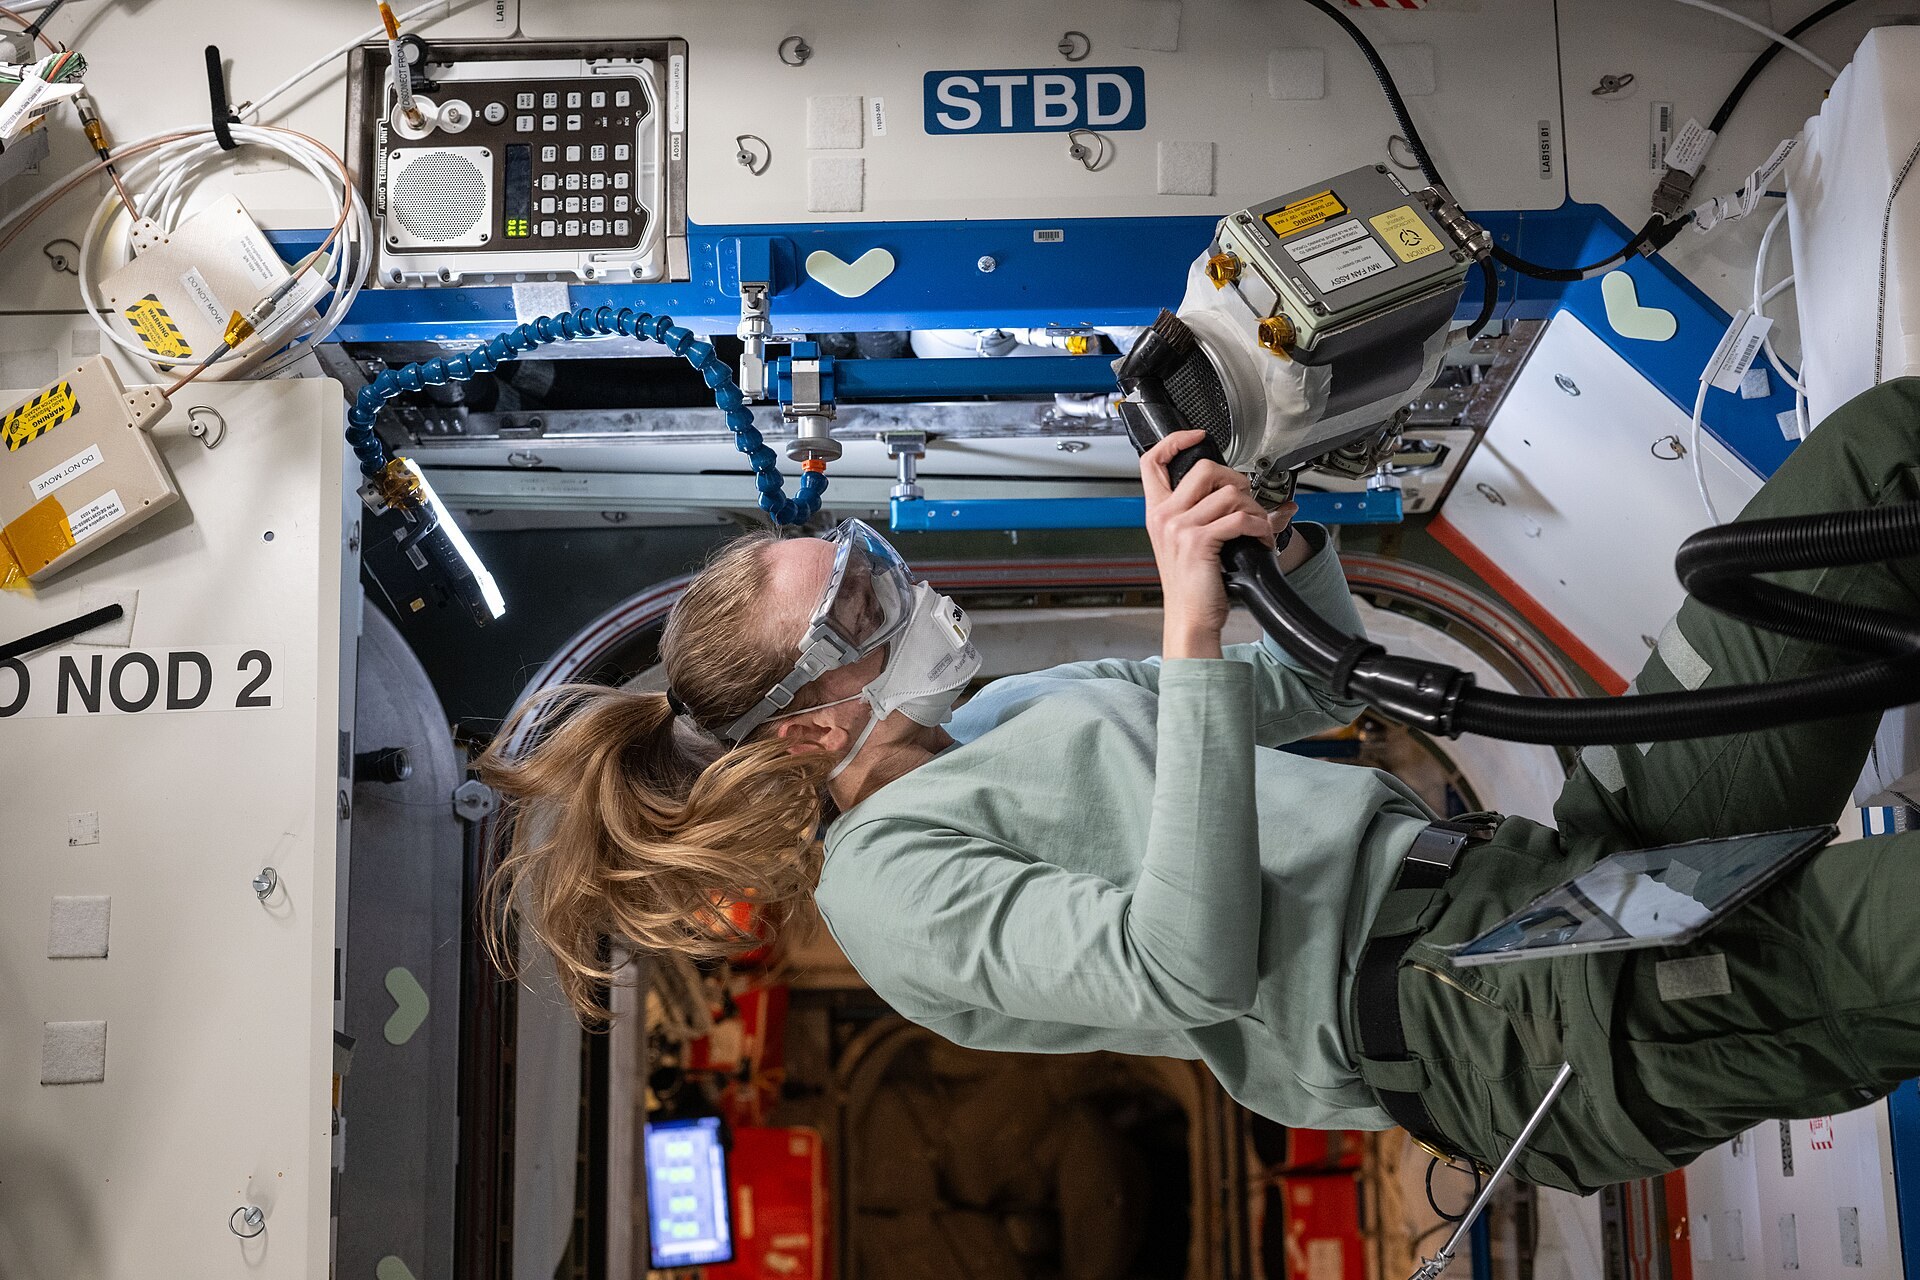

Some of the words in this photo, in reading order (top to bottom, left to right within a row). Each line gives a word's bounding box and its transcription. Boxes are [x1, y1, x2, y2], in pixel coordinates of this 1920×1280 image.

[936, 73, 1133, 130] STBD
[0, 114, 17, 132] EXPRESS
[1541, 140, 1550, 172] LAB1S1
[1300, 204, 1325, 216] SURFACES
[1293, 210, 1326, 227] WARNING
[519, 220, 527, 236] PTT
[1406, 243, 1436, 259] CAUTION
[1350, 267, 1367, 278] FAN
[1367, 262, 1382, 272] IMV
[1330, 274, 1350, 286] ASSY
[187, 276, 199, 288] DO
[195, 287, 210, 304] NOT
[206, 303, 225, 326] MOVE
[136, 313, 151, 332] RADIATION
[148, 331, 161, 347] HAZARD
[140, 310, 150, 323] RADIO
[147, 322, 165, 343] FREQUENCY
[146, 308, 170, 338] WARNING
[41, 393, 63, 409] RADIATION
[51, 397, 65, 408] RADIO
[24, 406, 41, 419] HAZARD
[27, 405, 52, 423] FREQUENCY
[31, 405, 66, 428] WARNING
[81, 454, 95, 465] DO
[62, 462, 81, 476] NOT
[37, 472, 63, 491] MOVE
[108, 507, 120, 517] RFID
[89, 513, 109, 528] Logistics
[71, 525, 89, 539] Antenna
[57, 652, 212, 714] NOD
[235, 650, 273, 707] 2
